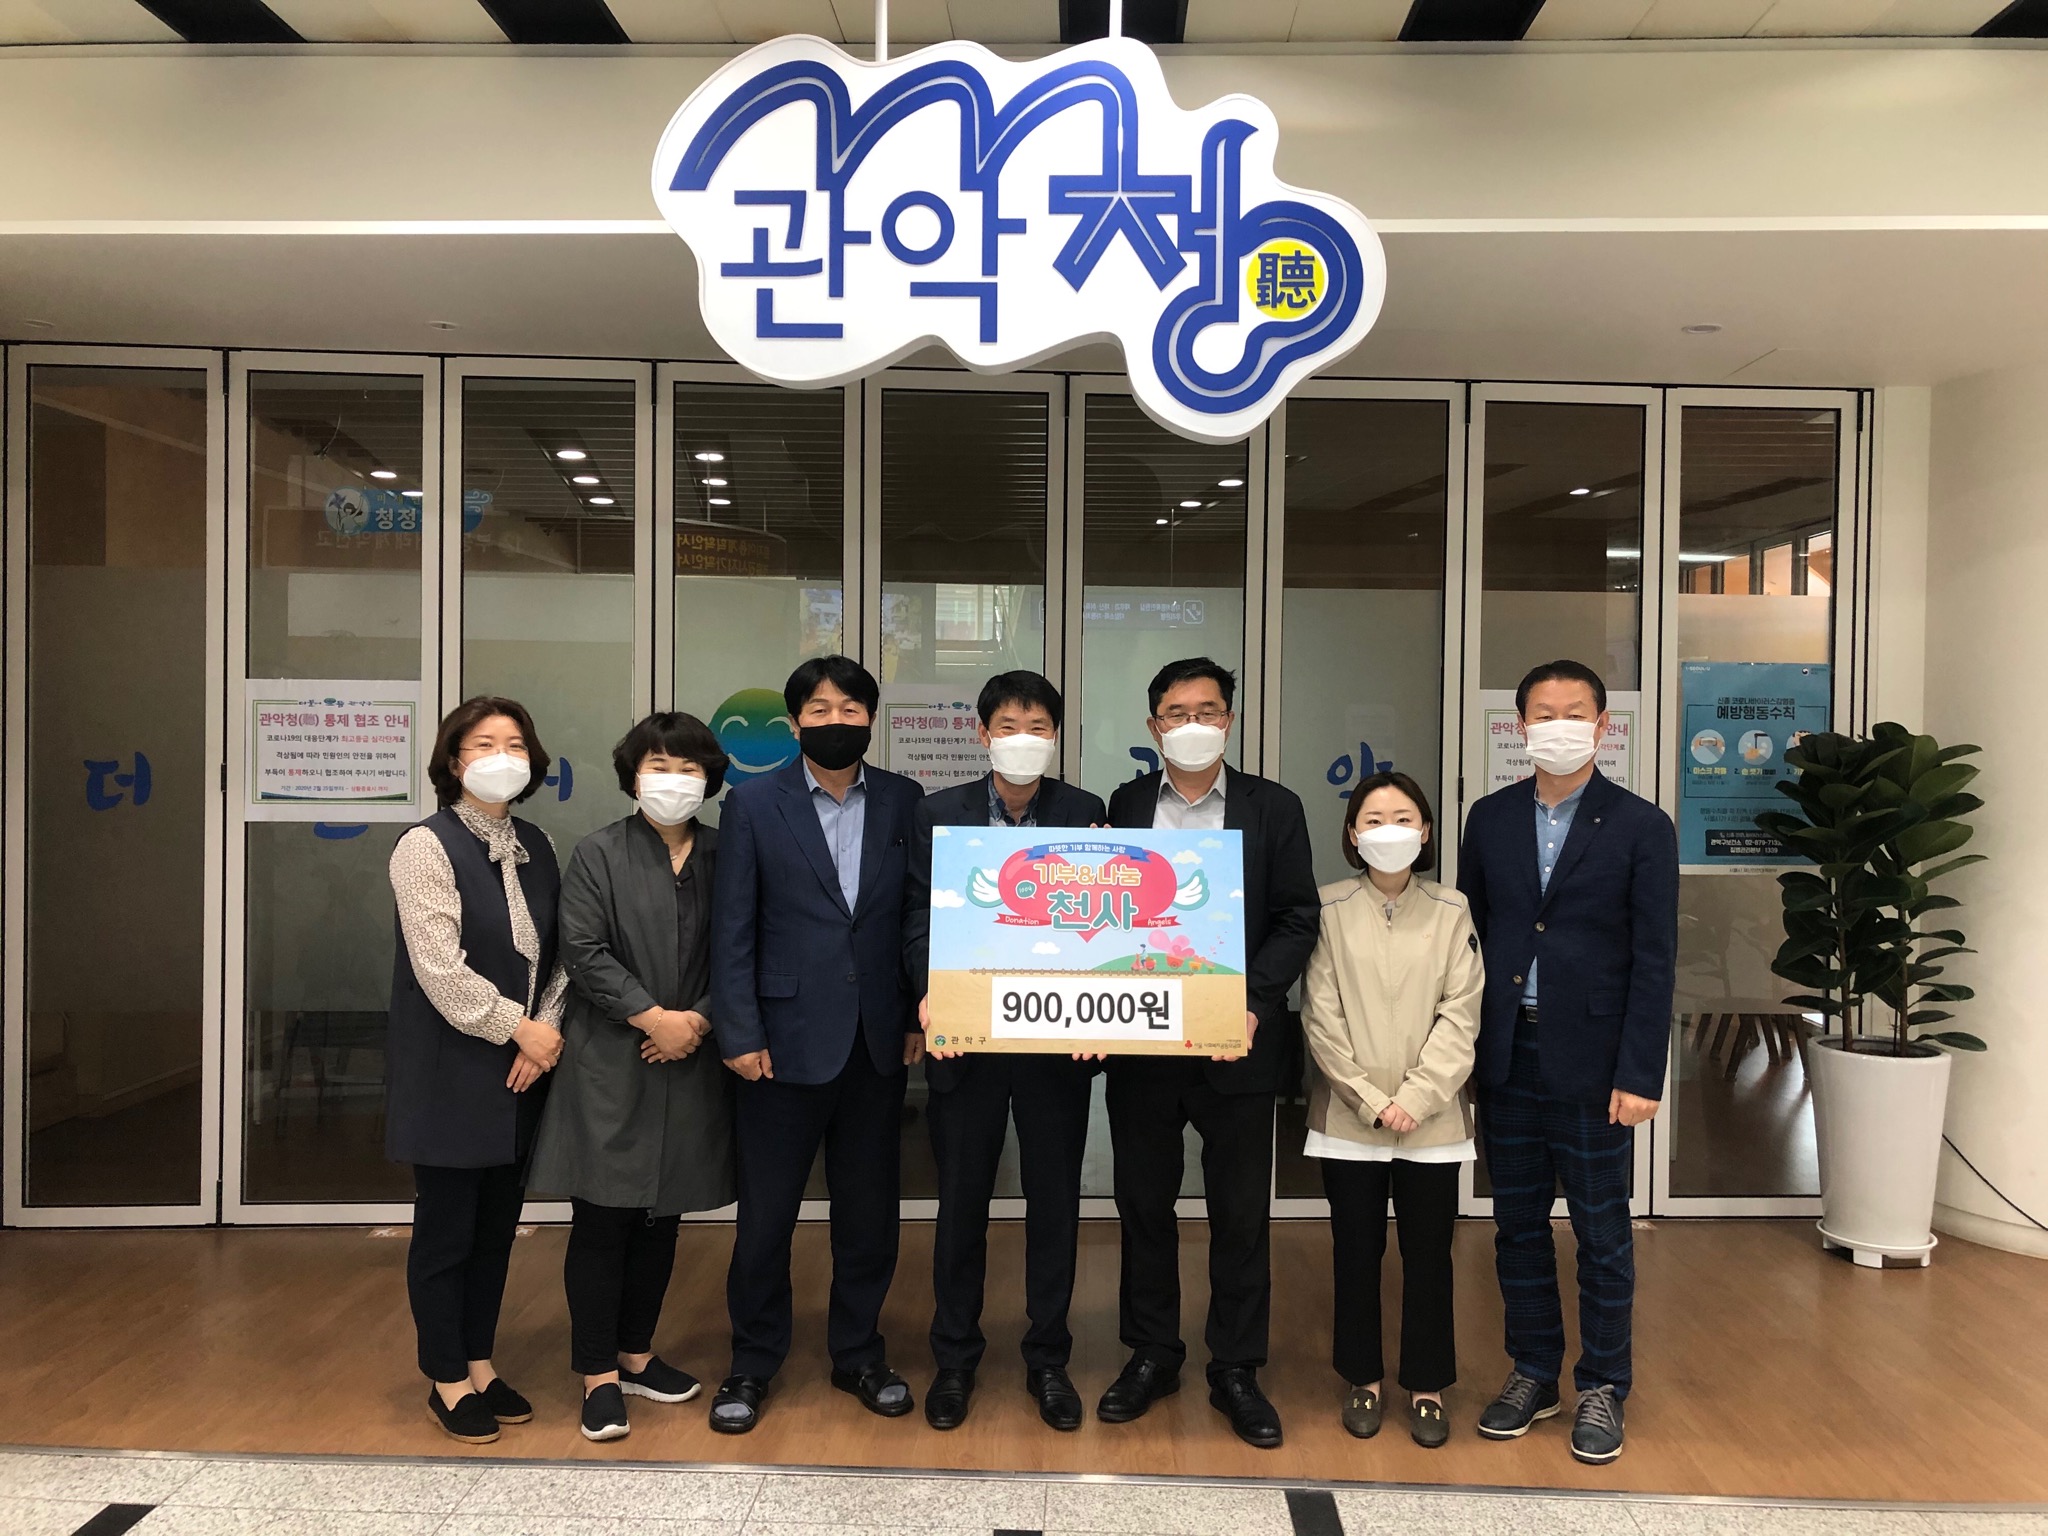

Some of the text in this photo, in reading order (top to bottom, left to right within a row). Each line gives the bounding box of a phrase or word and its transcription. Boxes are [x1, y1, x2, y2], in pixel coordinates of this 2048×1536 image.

[671, 60, 1364, 413] 관악청
[1256, 250, 1318, 312] 聽
[1717, 706, 1795, 720] 예방행동수칙
[324, 714, 349, 727] 통제
[354, 714, 380, 728] 협조
[384, 714, 409, 728] 안내
[952, 717, 976, 730] 통제
[1607, 724, 1628, 736] 안내
[376, 752, 396, 760] 위하여
[83, 751, 152, 811] 더
[1049, 844, 1126, 853] 따뜻한 기부 함께하는 사랑
[1033, 863, 1142, 887] 기부&나눔
[1047, 890, 1139, 933] 천사
[1005, 916, 1040, 926] Donation
[1147, 917, 1172, 927] Angels
[1002, 990, 1170, 1030] 900,000원
